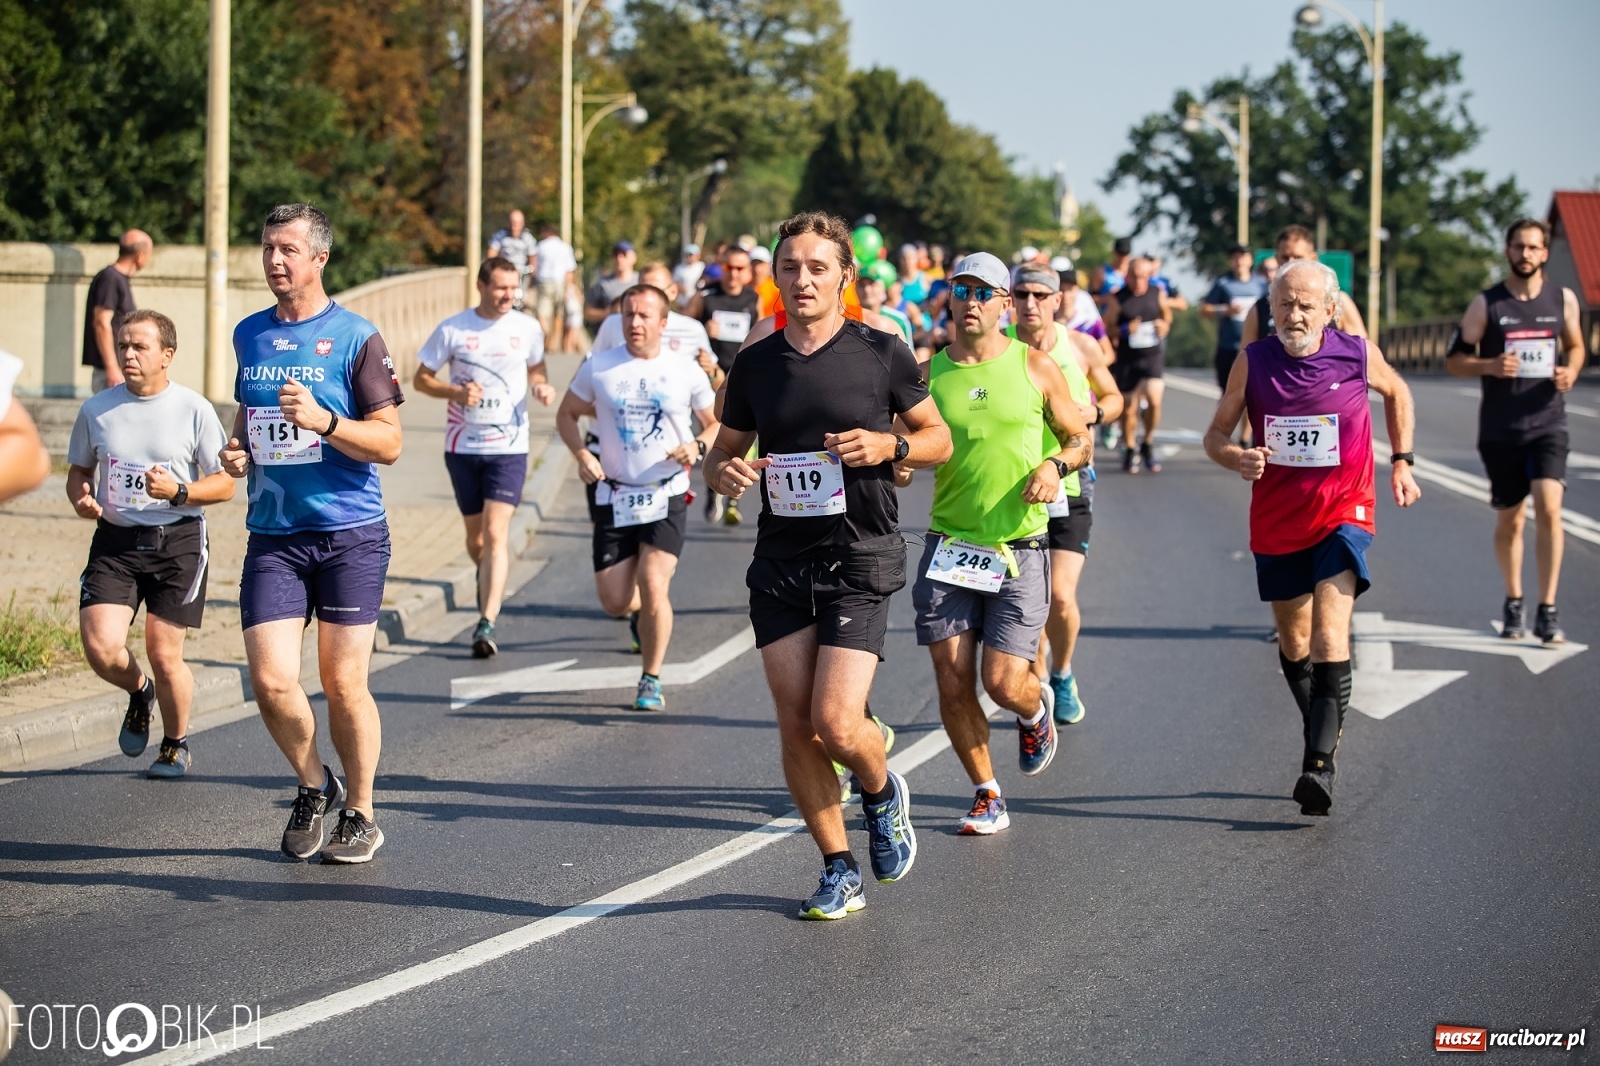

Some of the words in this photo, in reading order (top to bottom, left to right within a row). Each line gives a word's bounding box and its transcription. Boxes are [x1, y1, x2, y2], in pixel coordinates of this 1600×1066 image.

[243, 366, 325, 382] RUNNERS
[247, 383, 283, 391] EKO-OKN
[268, 423, 298, 441] 151
[1287, 431, 1320, 446] 347
[125, 474, 144, 490] 36
[786, 470, 822, 491] 119
[629, 494, 652, 508] 383
[956, 552, 991, 571] 248
